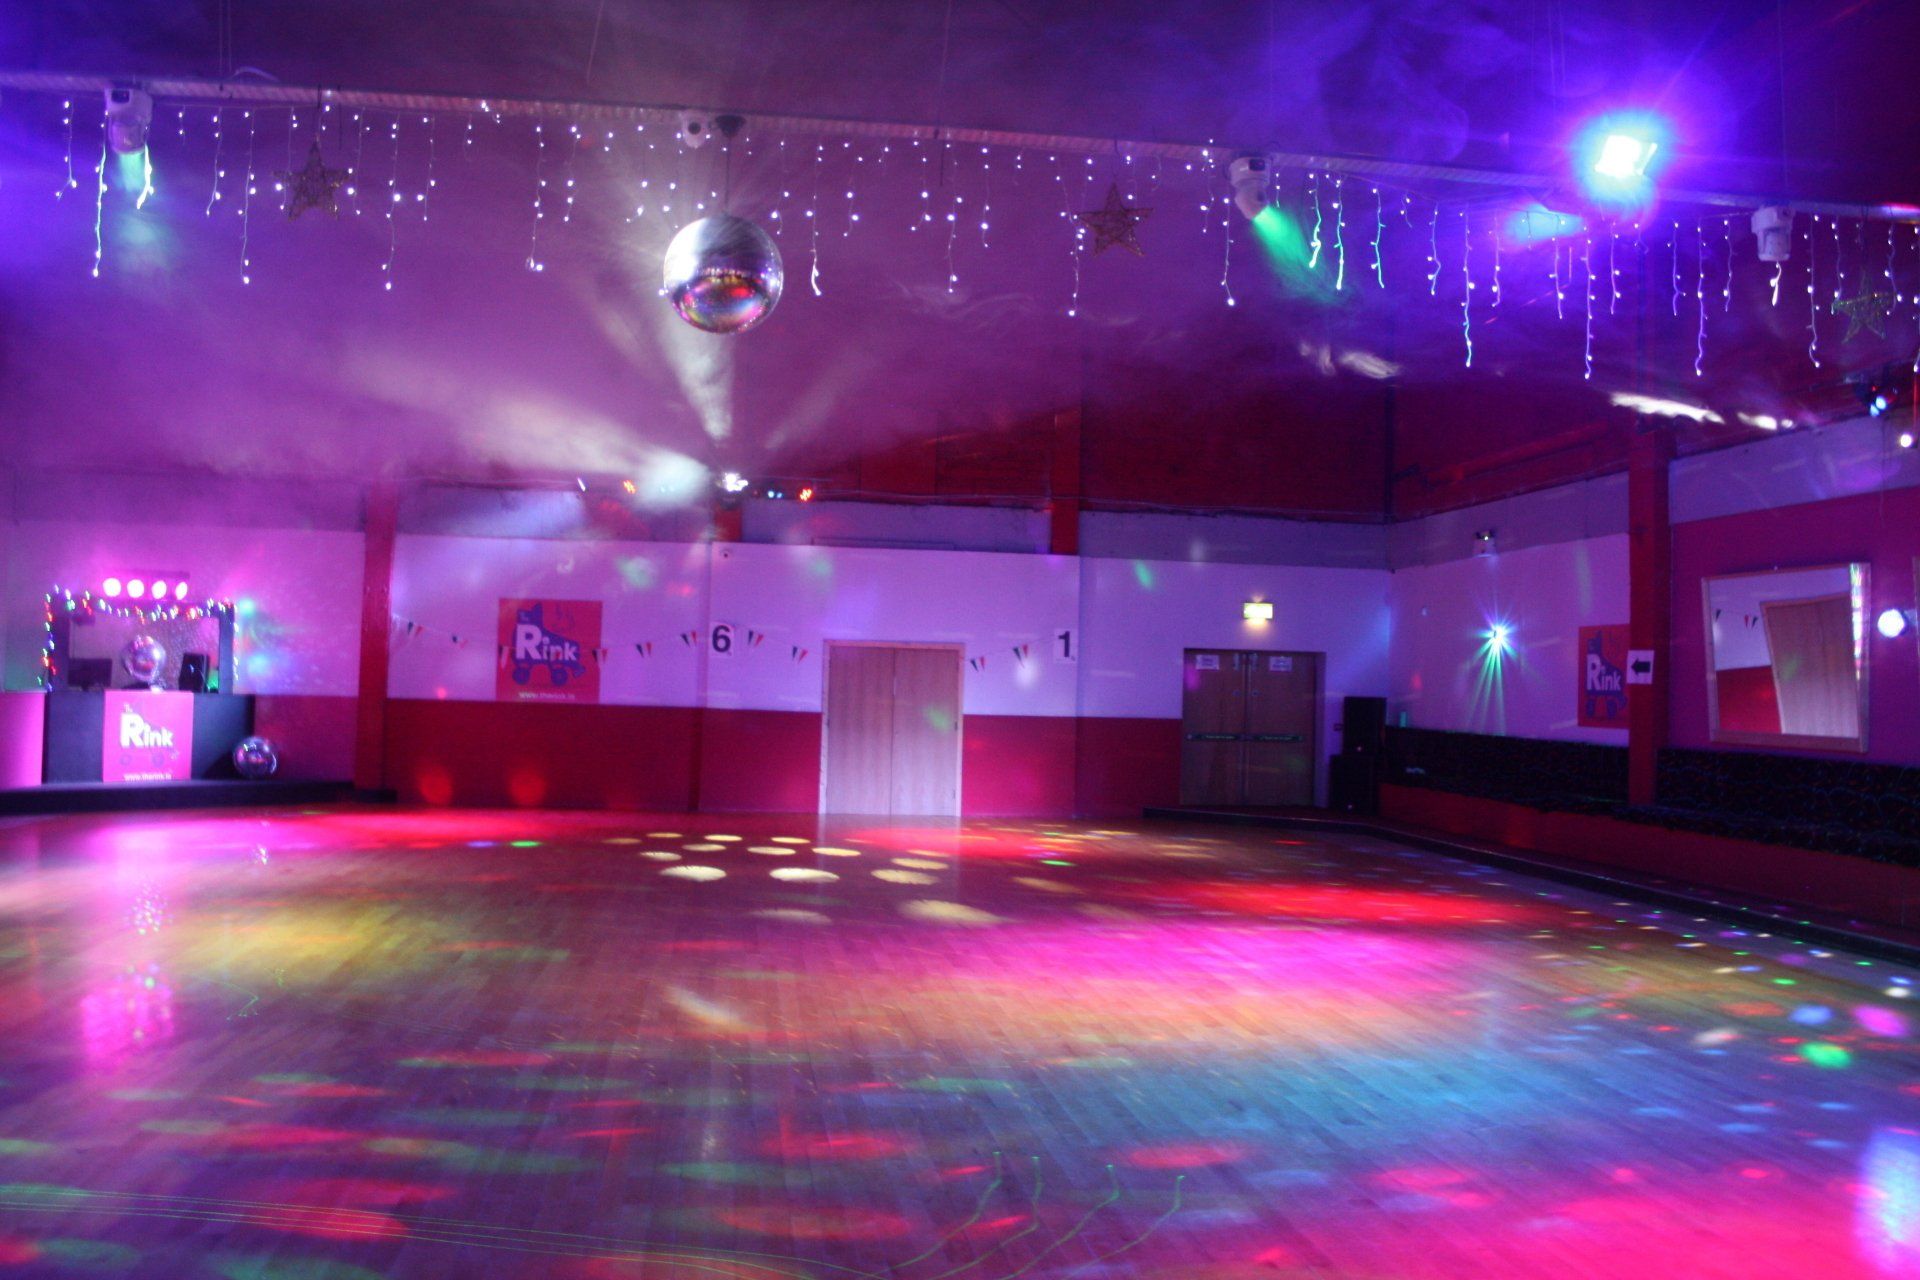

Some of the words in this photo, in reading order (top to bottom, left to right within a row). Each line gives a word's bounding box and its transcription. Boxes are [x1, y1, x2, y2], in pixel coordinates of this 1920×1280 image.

[516, 624, 578, 661] Rink
[712, 625, 731, 653] 6
[1058, 631, 1070, 658] 1
[1586, 653, 1621, 691] Rink
[120, 713, 174, 748] Rink
